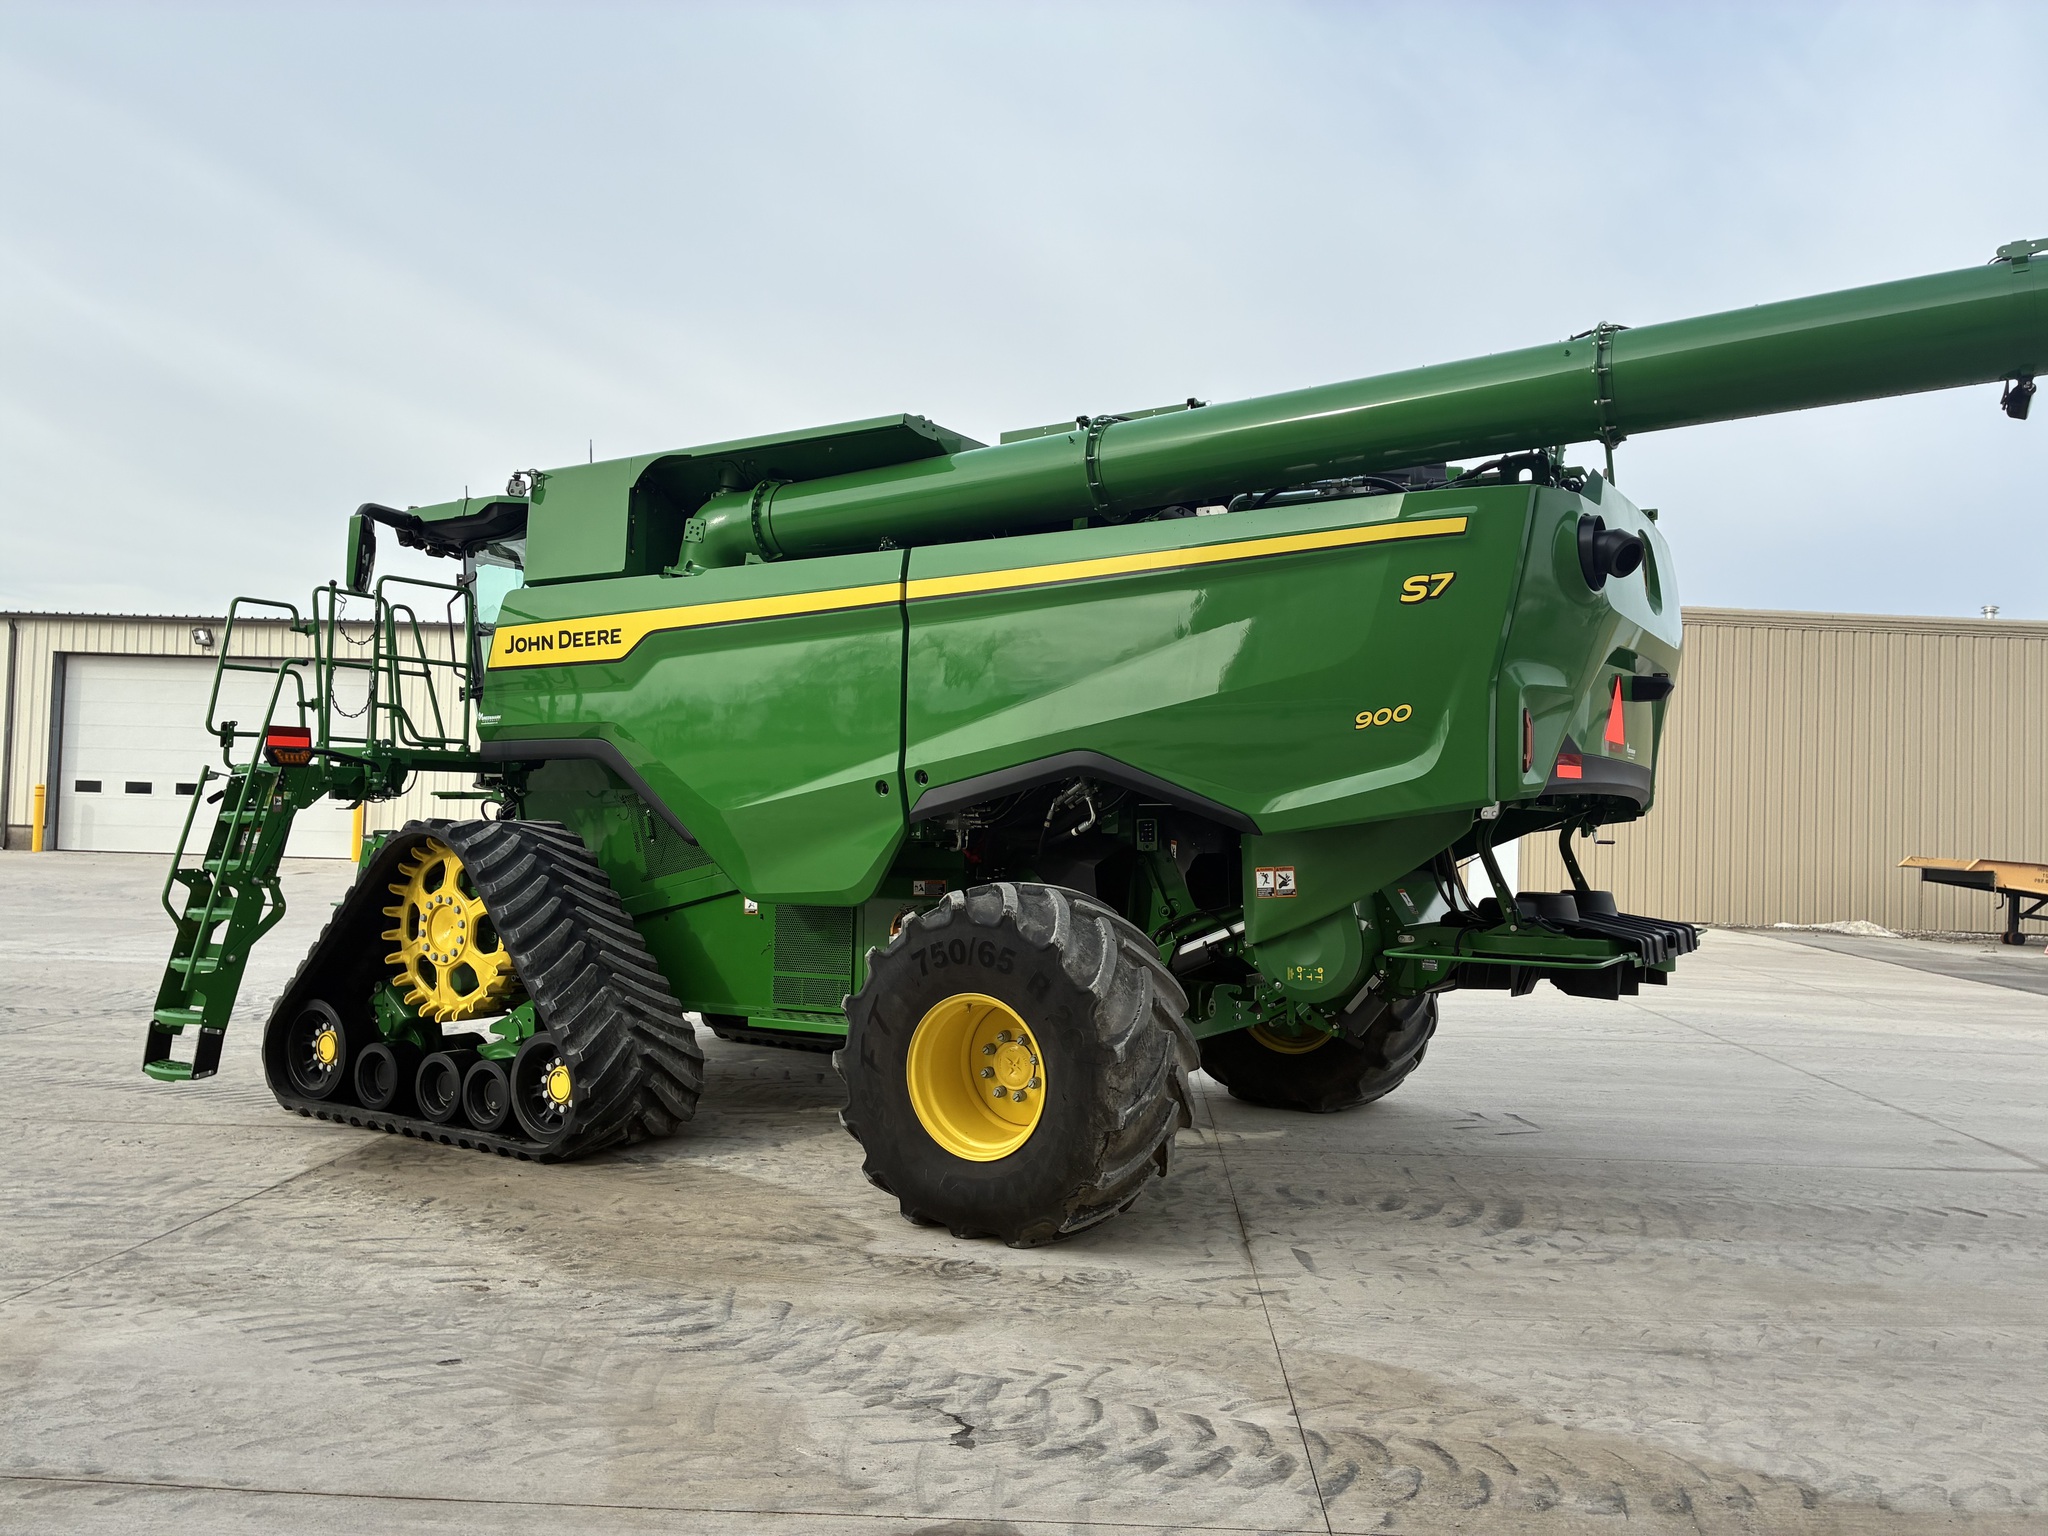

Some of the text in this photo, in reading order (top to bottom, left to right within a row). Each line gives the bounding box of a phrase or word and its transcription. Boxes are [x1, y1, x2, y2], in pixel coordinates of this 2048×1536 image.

[1400, 572, 1456, 605] S7
[505, 628, 621, 654] JOHN DEERE
[1354, 703, 1413, 730] 900
[911, 937, 1017, 977] 750/65
